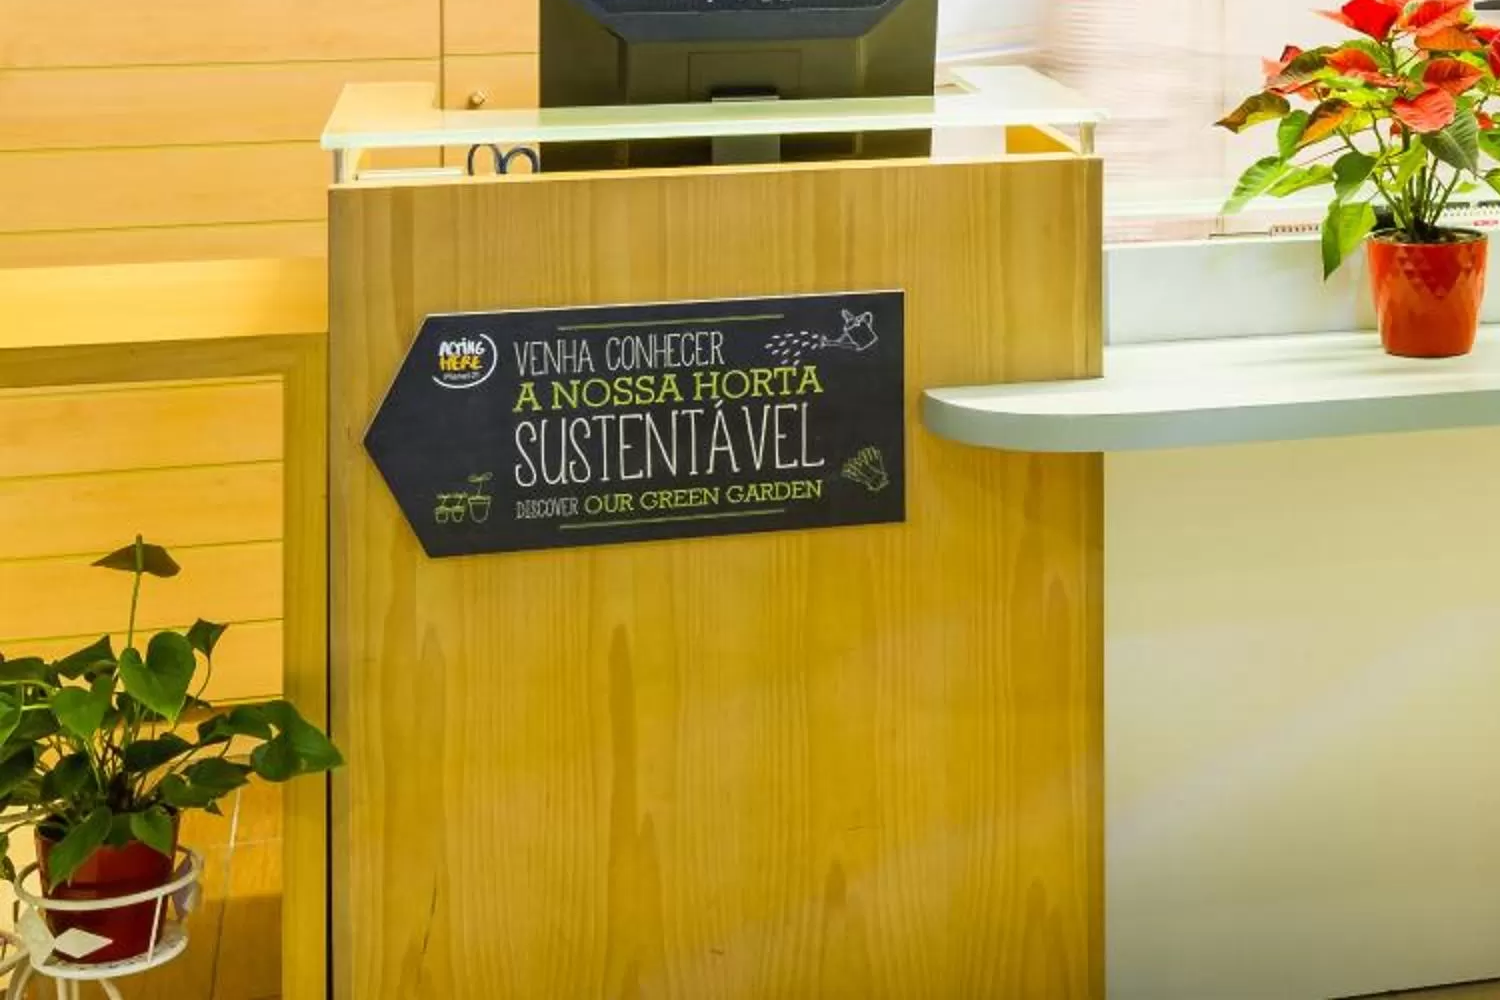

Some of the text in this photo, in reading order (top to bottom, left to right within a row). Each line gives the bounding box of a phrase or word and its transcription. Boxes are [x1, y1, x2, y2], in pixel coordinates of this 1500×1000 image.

[513, 331, 726, 377] VENHA CONHECER
[512, 365, 824, 413] A NOSSA HORTA
[514, 399, 826, 488] SUSTENTÁVEL
[516, 479, 824, 520] DISCOVER OUR GREEN GARDEN
